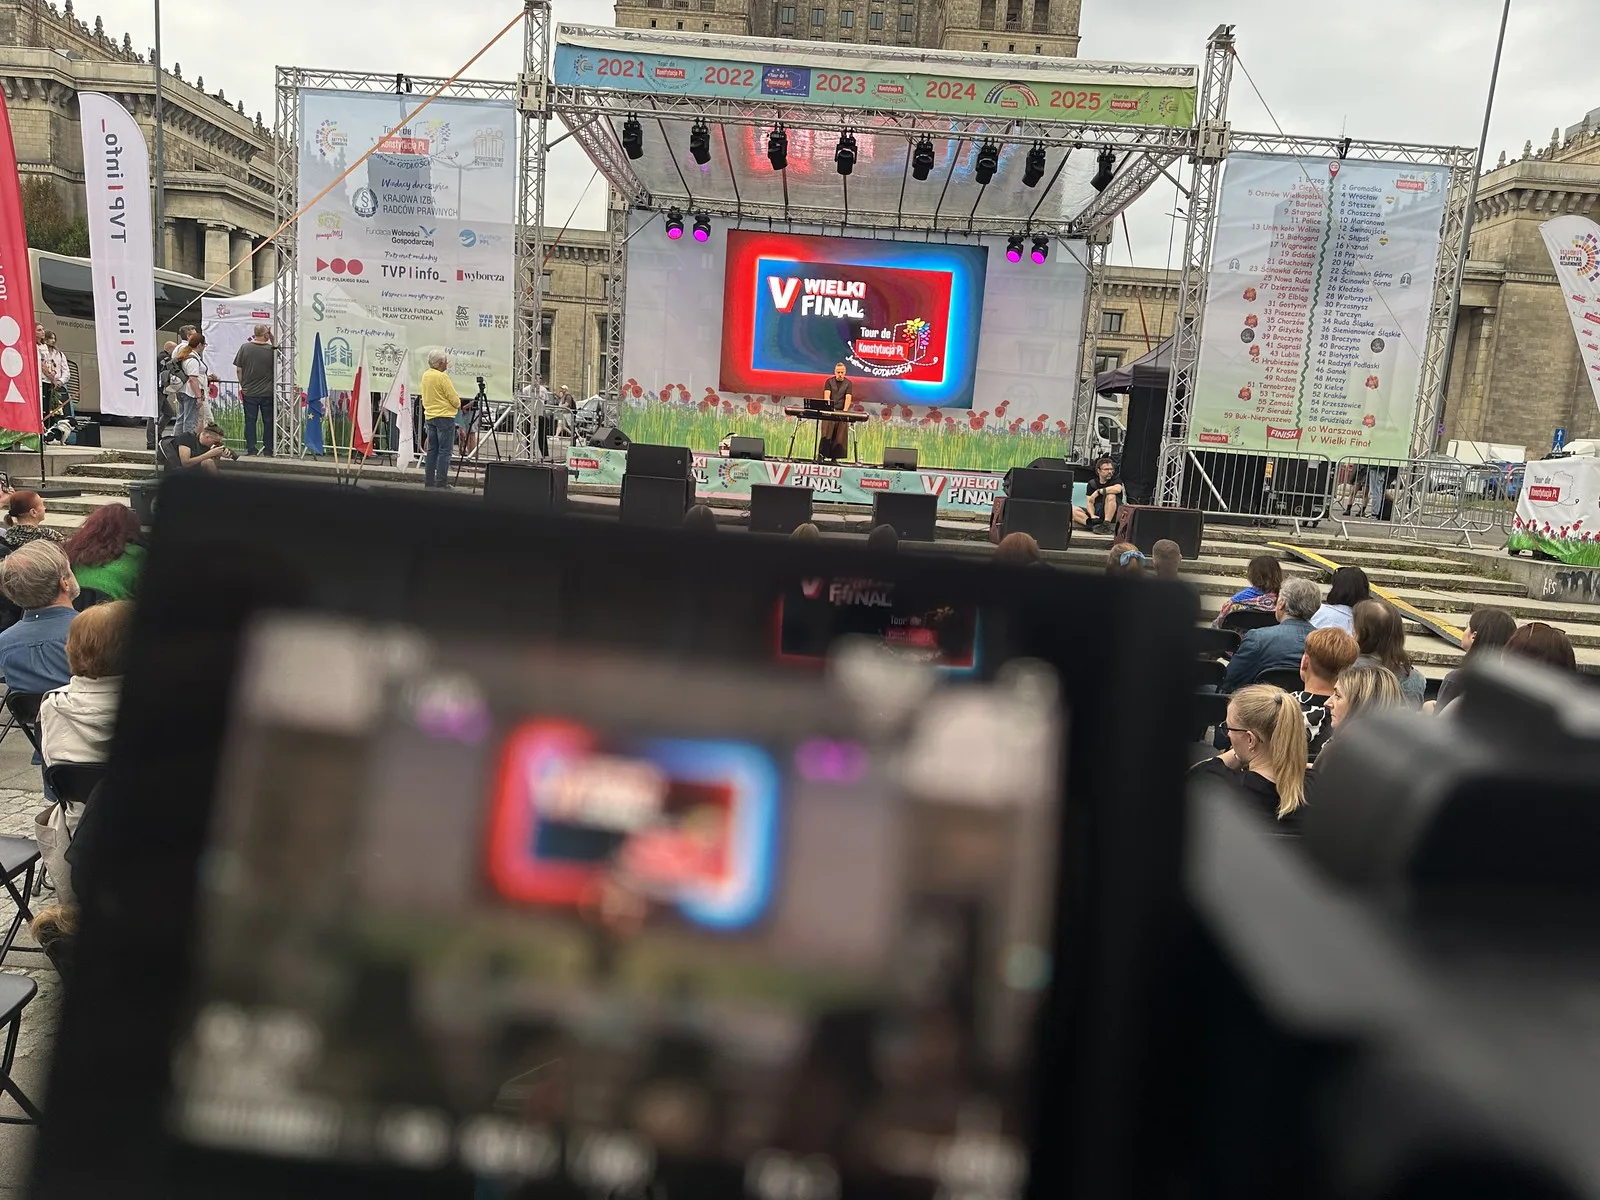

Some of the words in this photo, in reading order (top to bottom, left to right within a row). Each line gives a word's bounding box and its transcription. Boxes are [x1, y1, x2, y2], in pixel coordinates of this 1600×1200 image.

[597, 57, 645, 78] 2021
[704, 66, 755, 87] 2022
[816, 74, 866, 95] 2023
[925, 81, 977, 101] 2024
[1049, 90, 1101, 111] 2025
[1348, 185, 1382, 193] Gromadka
[382, 194, 418, 204] KRAJOWA
[420, 197, 436, 205] IZBA
[1255, 190, 1280, 198] Ostrów
[1282, 191, 1324, 200] Wielkopolski
[1348, 193, 1379, 201] Wrocław
[383, 204, 414, 215] RADCÓW
[416, 206, 458, 217] PRAWNYCH
[1291, 208, 1322, 217] Stargard
[1347, 209, 1381, 218] Choszczno
[1302, 217, 1321, 225] Police
[391, 229, 420, 237] Wolności
[391, 237, 434, 247] Gospodarczej
[1281, 242, 1317, 251] Wągrowiec
[1291, 251, 1316, 259] Gdańsk
[381, 264, 407, 278] TVP
[464, 270, 505, 282] wyborcza
[1274, 275, 1292, 283] Nowa
[1338, 285, 1364, 293] Kłodzko
[767, 276, 803, 313] V
[803, 278, 867, 299] WIELKI
[1278, 301, 1307, 311] Gostynin
[1335, 310, 1362, 319] Tarczyn
[860, 327, 880, 337] Tour
[880, 328, 891, 339] de
[477, 349, 485, 357] IT
[858, 342, 895, 357] Konstytucja
[896, 344, 904, 354] PL
[1329, 352, 1360, 360] Białystok
[1276, 367, 1298, 375] Krosno
[1325, 376, 1346, 384] Mrozy
[1258, 382, 1296, 392] Tarnobrzeg
[1271, 391, 1295, 399] Tarnów
[1323, 391, 1347, 400] Kraków
[1322, 400, 1362, 409] Krzeszowice
[1266, 407, 1293, 415] Sieradz
[1321, 408, 1348, 416] Parczew
[1270, 429, 1298, 439] FINISH
[1319, 425, 1363, 436] Warszawa
[1310, 435, 1317, 443] V
[1320, 436, 1347, 445] Wielki
[1350, 438, 1372, 447] Finał
[764, 462, 791, 485] V
[793, 464, 842, 478] WIELKI
[1534, 475, 1544, 484] Tour
[1544, 476, 1551, 484] de
[920, 475, 948, 496] V
[949, 476, 999, 491] WIELKI
[1530, 488, 1552, 499] Konstytucja
[1552, 489, 1557, 498] PL
